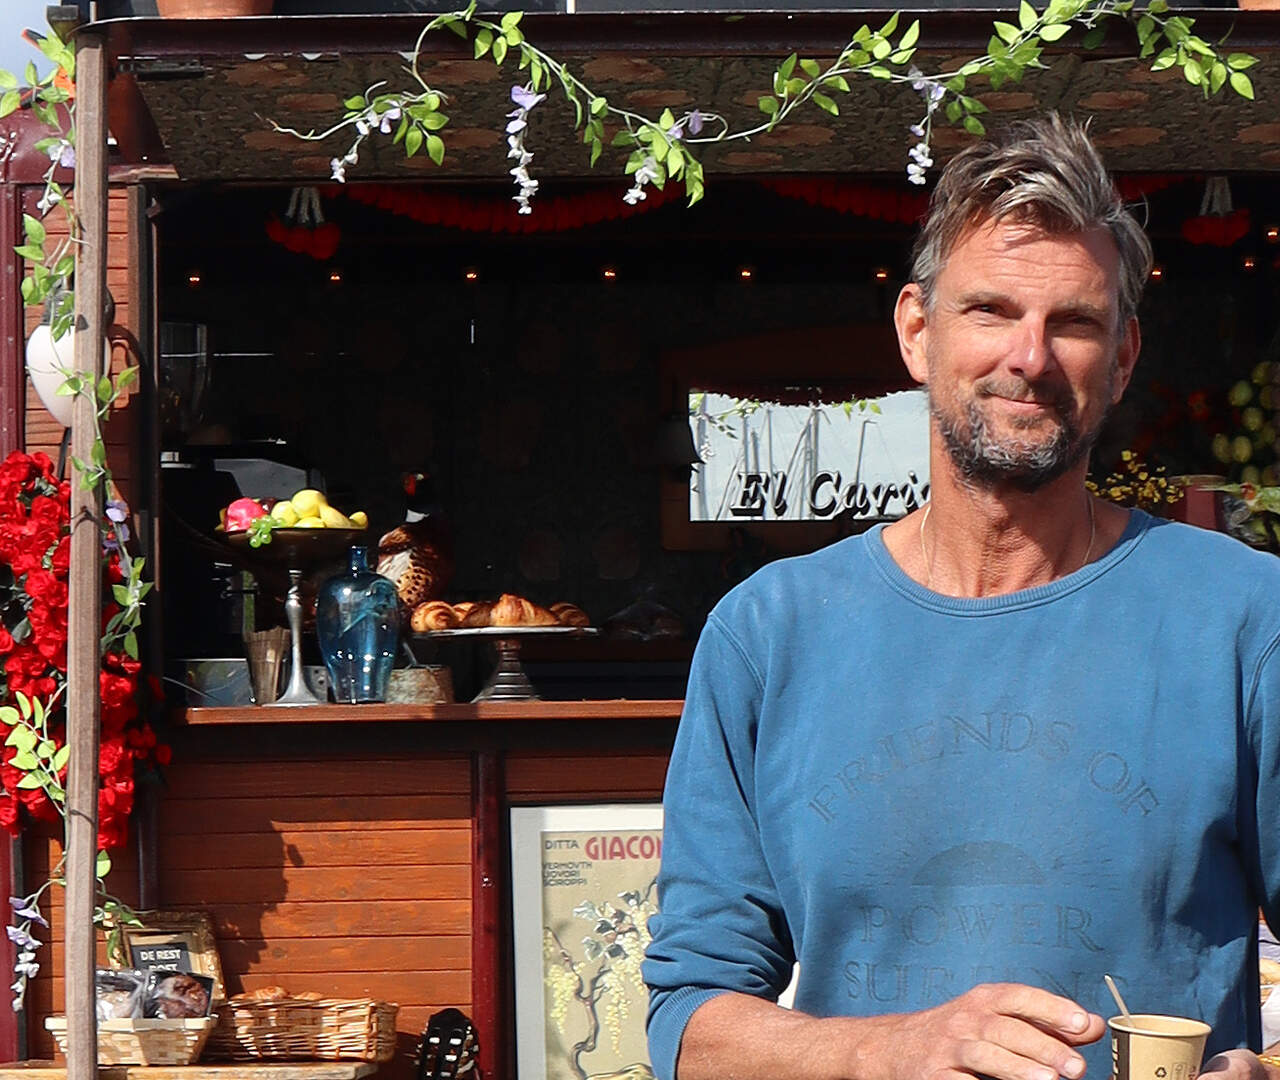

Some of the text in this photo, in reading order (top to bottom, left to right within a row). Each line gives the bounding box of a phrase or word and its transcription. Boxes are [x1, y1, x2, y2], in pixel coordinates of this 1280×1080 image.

[730, 470, 931, 517] El Cari
[808, 711, 1161, 823] FRIENDS OF
[545, 839, 579, 850] DITTA
[859, 904, 1106, 952] POWER
[140, 949, 181, 961] DE REST
